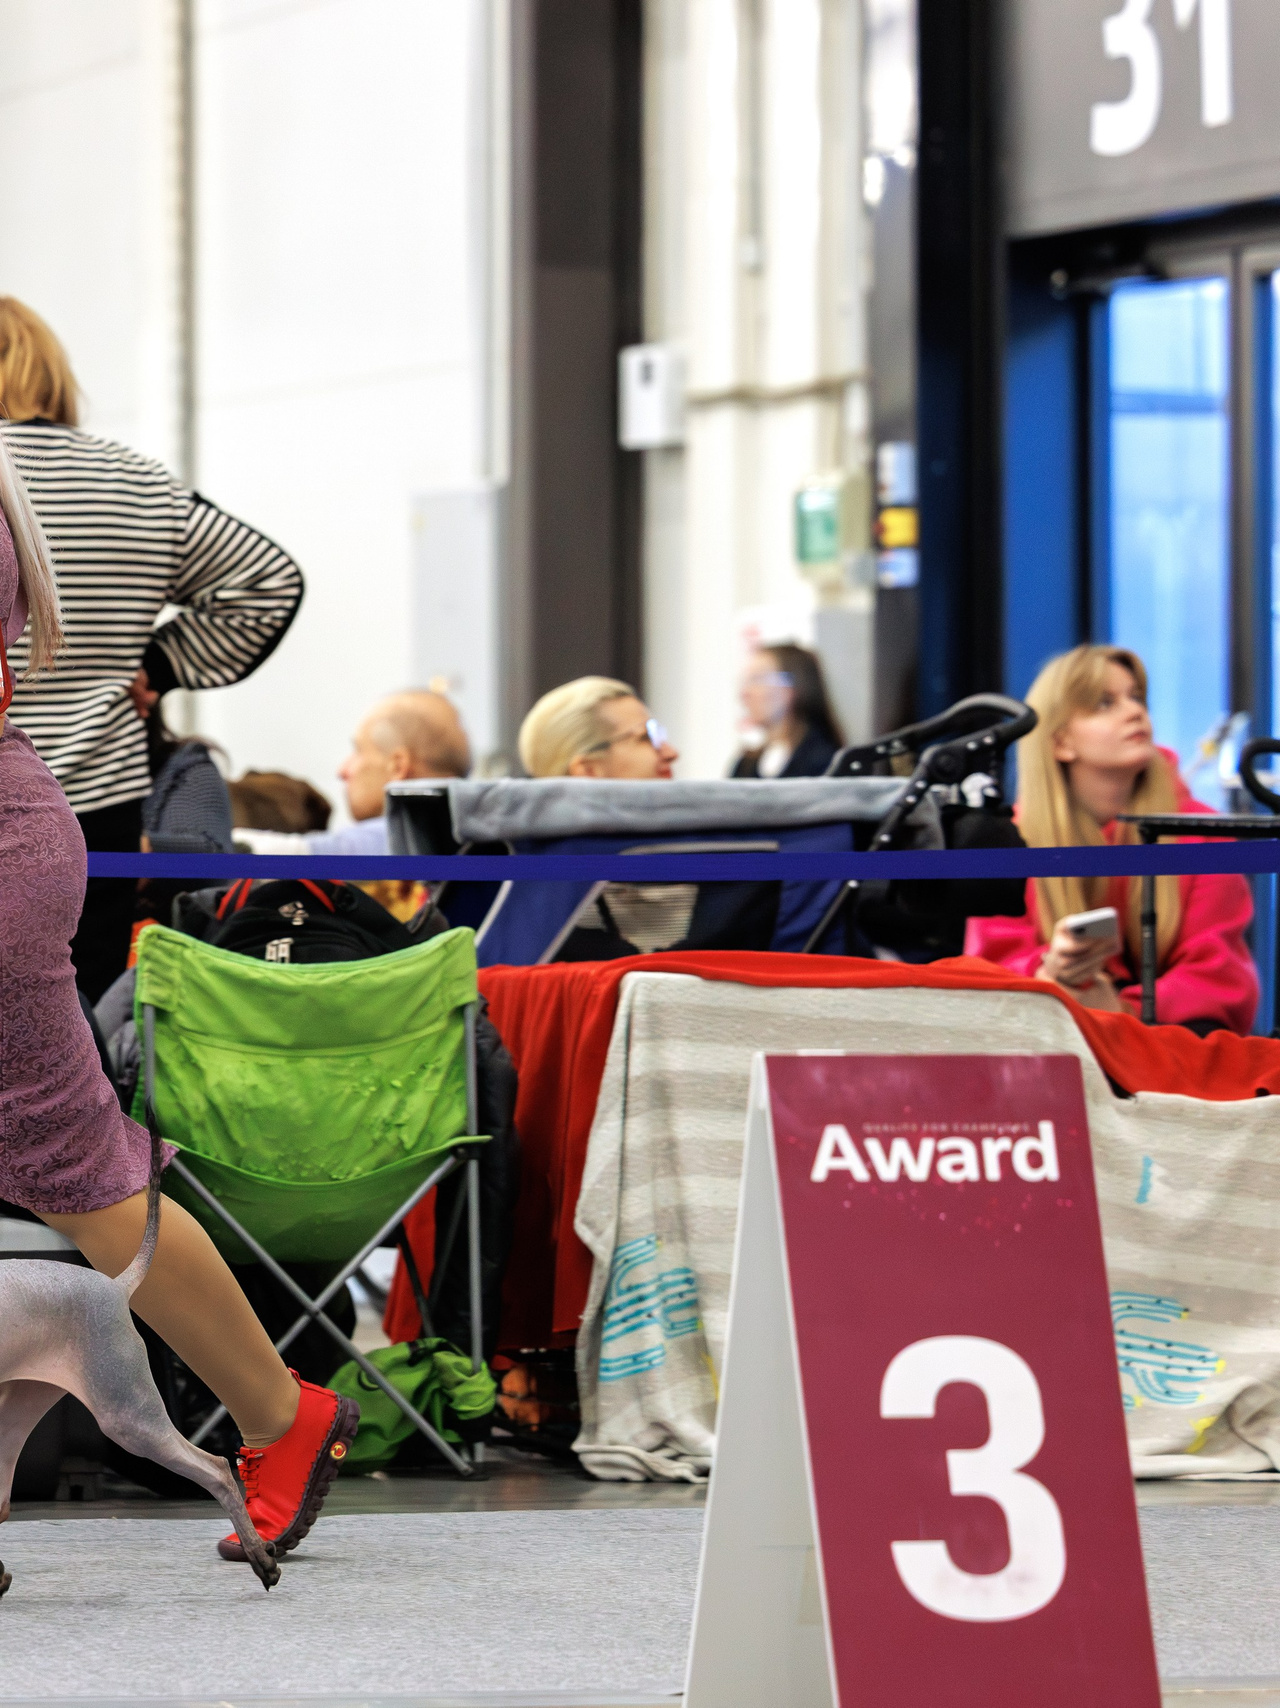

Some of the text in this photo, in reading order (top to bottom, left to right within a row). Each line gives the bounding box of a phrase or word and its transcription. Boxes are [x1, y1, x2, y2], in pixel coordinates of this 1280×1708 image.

[1090, 0, 1232, 156] 31
[810, 1121, 1060, 1183] Award
[880, 1335, 1067, 1623] 3
